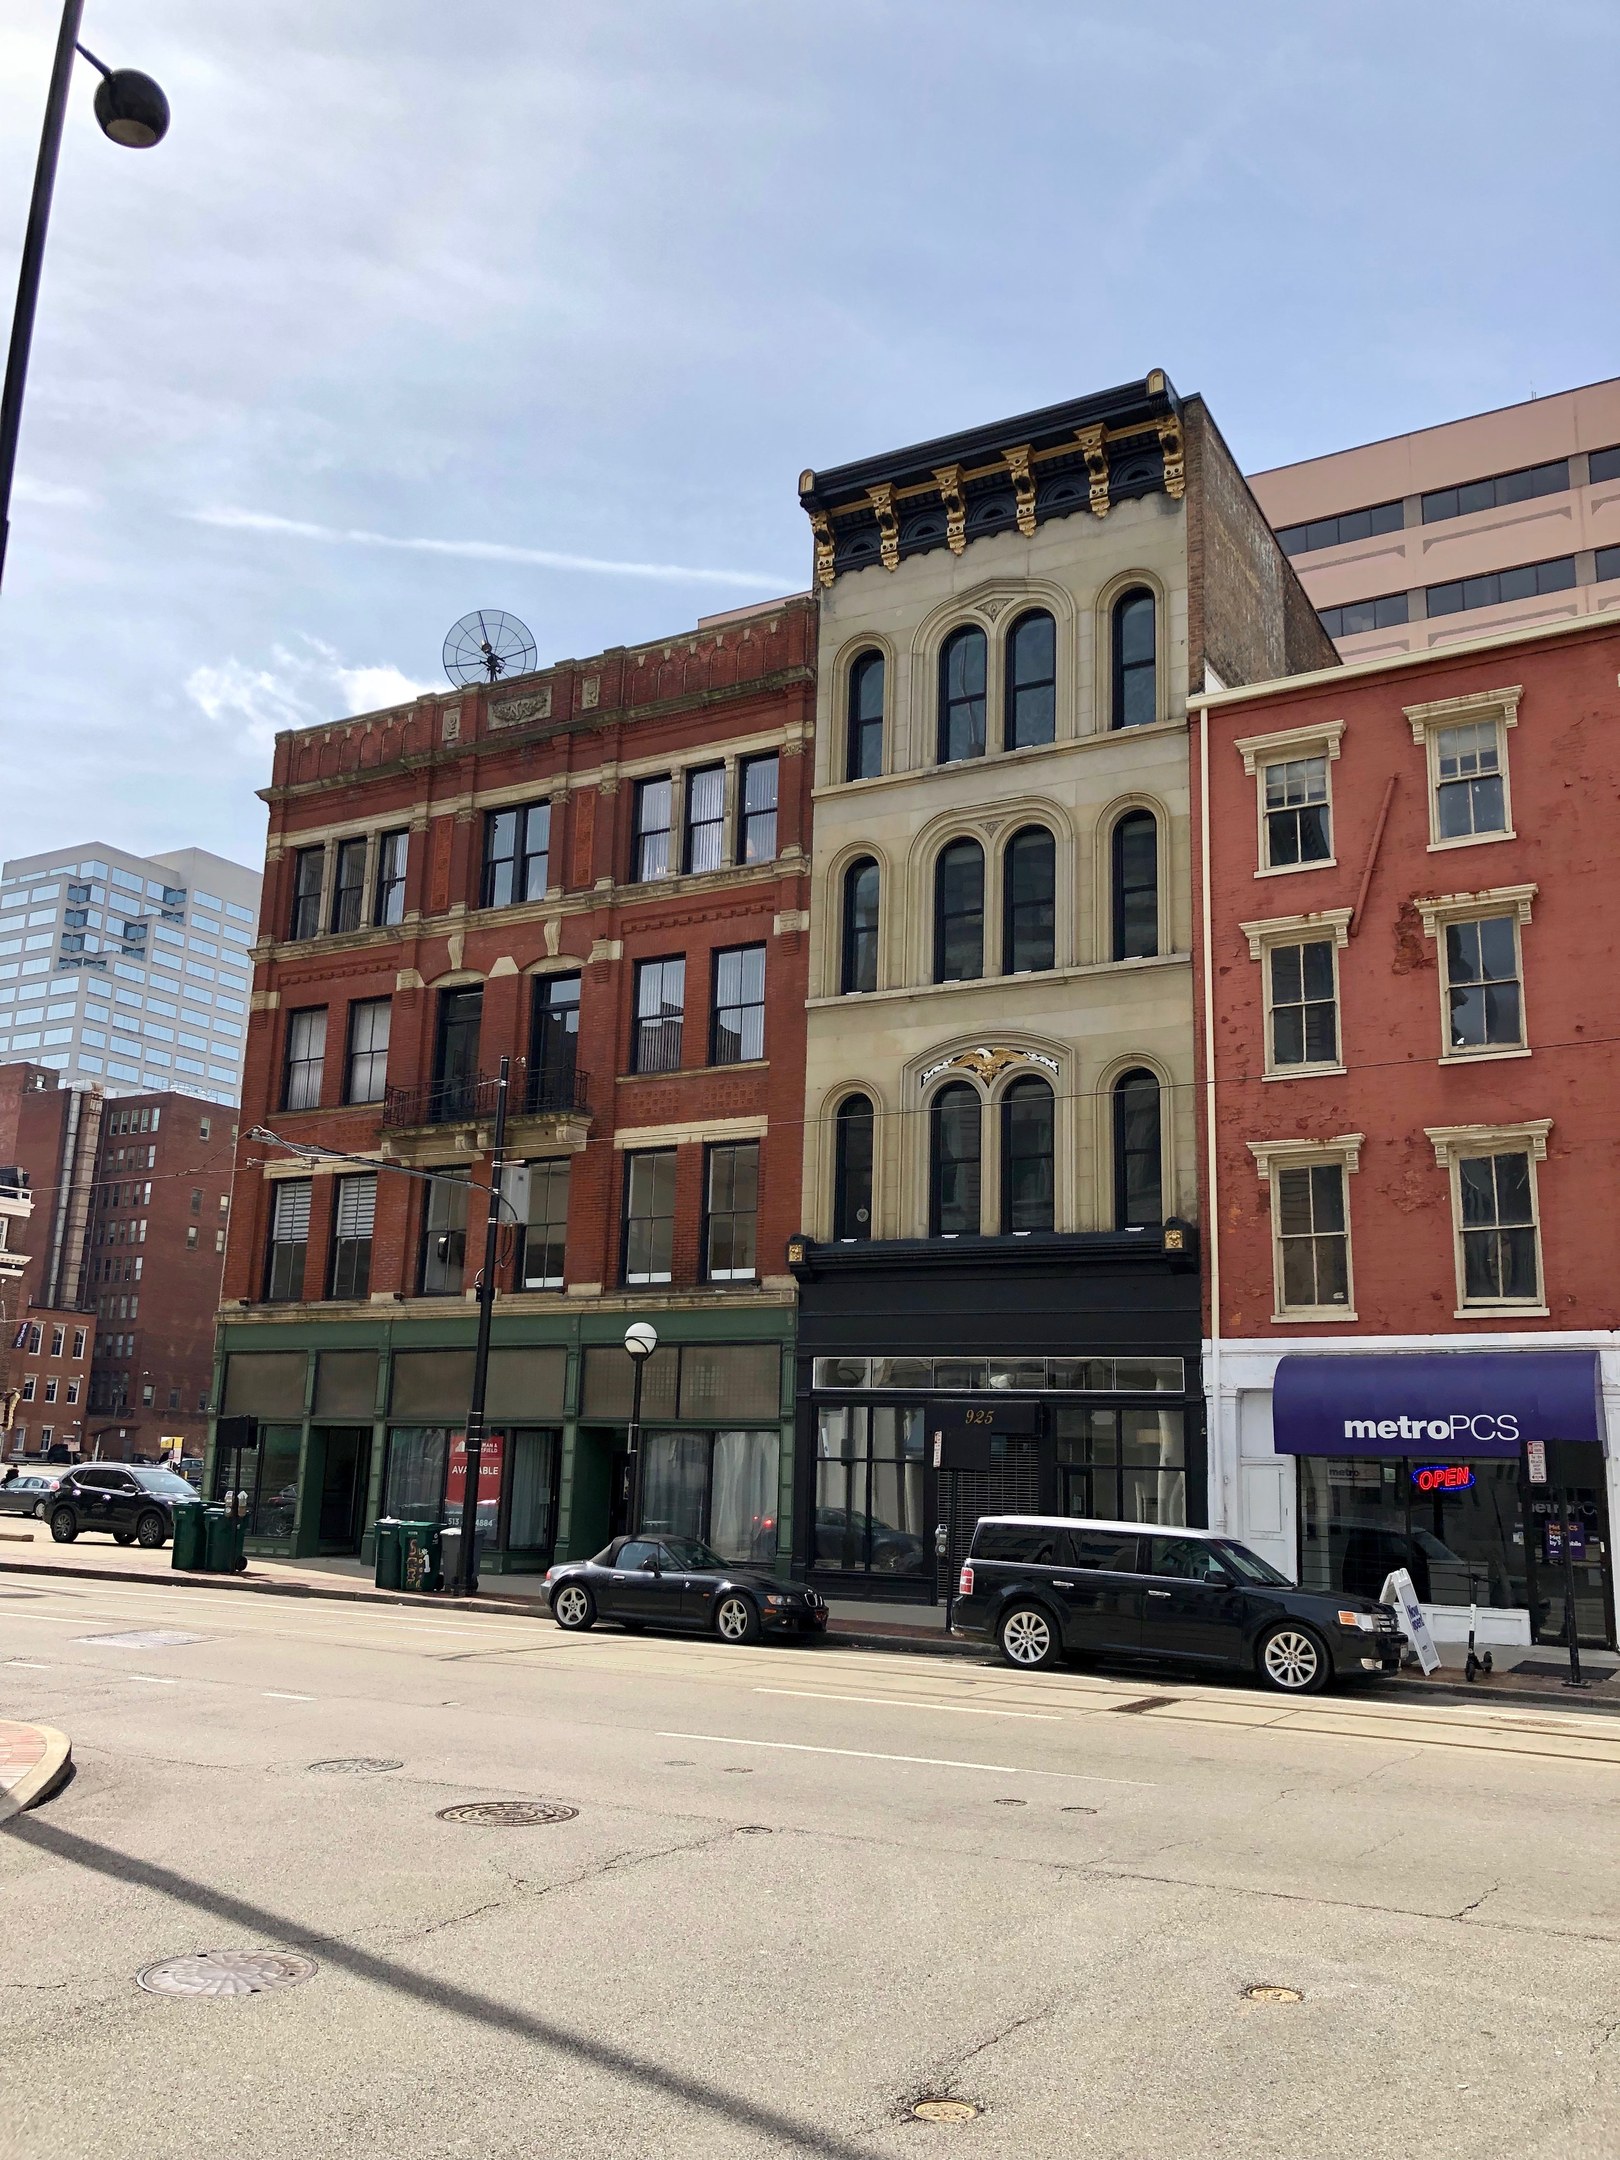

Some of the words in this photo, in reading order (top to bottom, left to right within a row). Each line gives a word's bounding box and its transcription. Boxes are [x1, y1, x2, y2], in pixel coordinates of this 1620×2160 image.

[965, 1409, 995, 1424] 925
[1344, 1414, 1520, 1441] metroPCS
[452, 1465, 499, 1475] AVAABLE
[1419, 1467, 1469, 1490] OPEN
